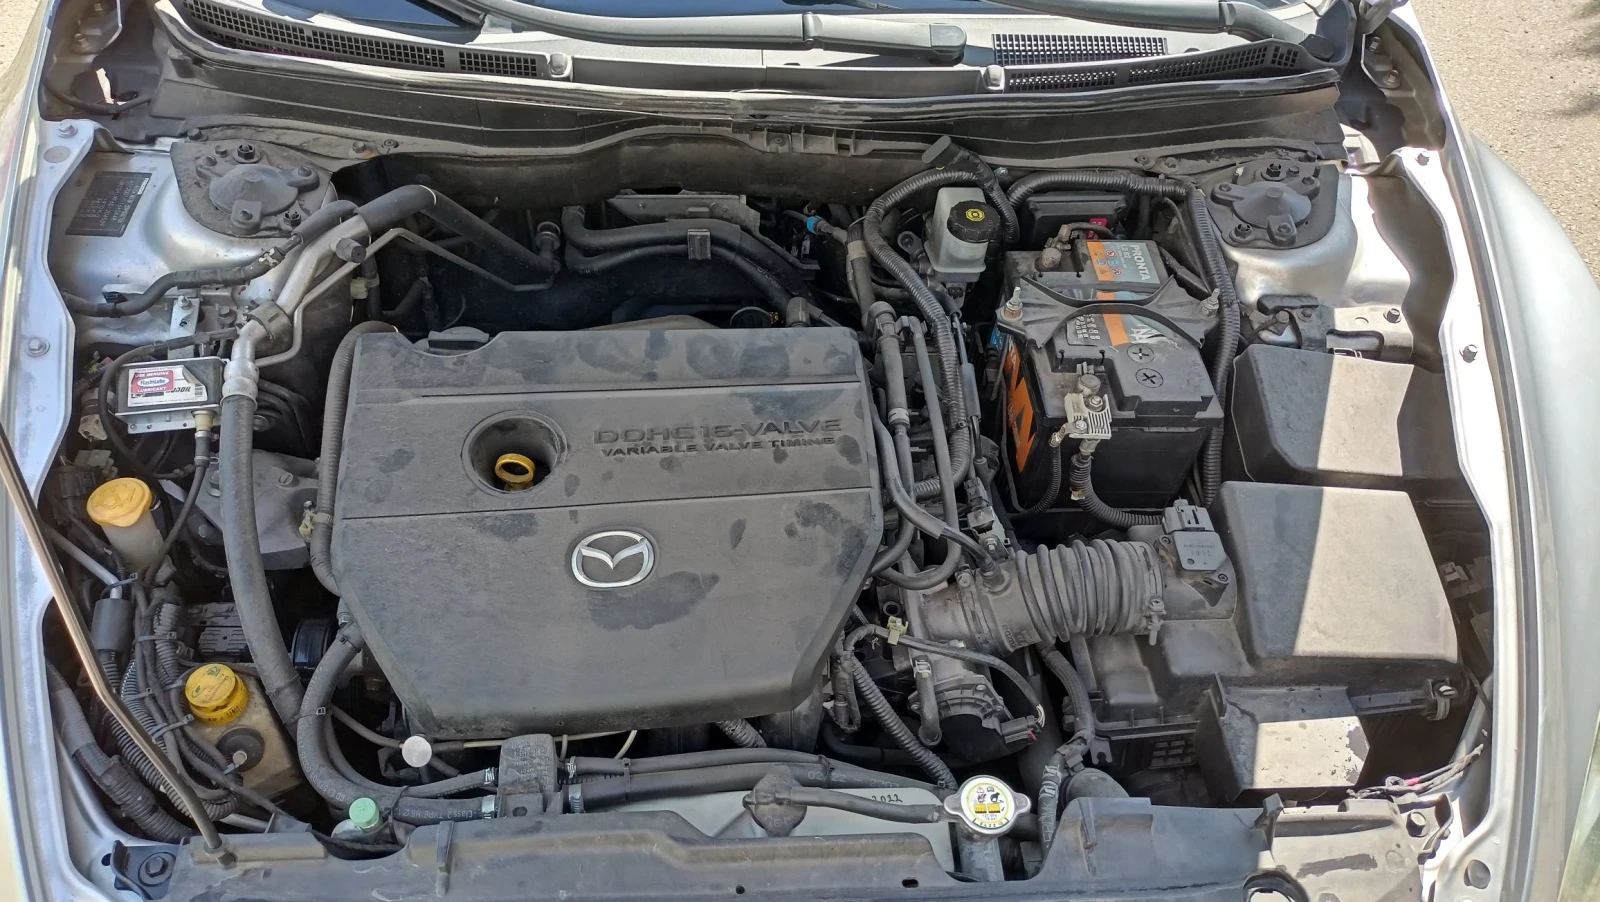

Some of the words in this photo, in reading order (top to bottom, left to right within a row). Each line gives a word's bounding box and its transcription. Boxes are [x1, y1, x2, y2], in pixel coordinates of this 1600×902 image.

[1129, 244, 1151, 280] PRONTA
[593, 425, 695, 444] DOHC
[601, 443, 699, 457] VARIABLE
[704, 440, 763, 451] VALVE
[771, 436, 837, 448] TIMING
[423, 810, 443, 819] TYPE
